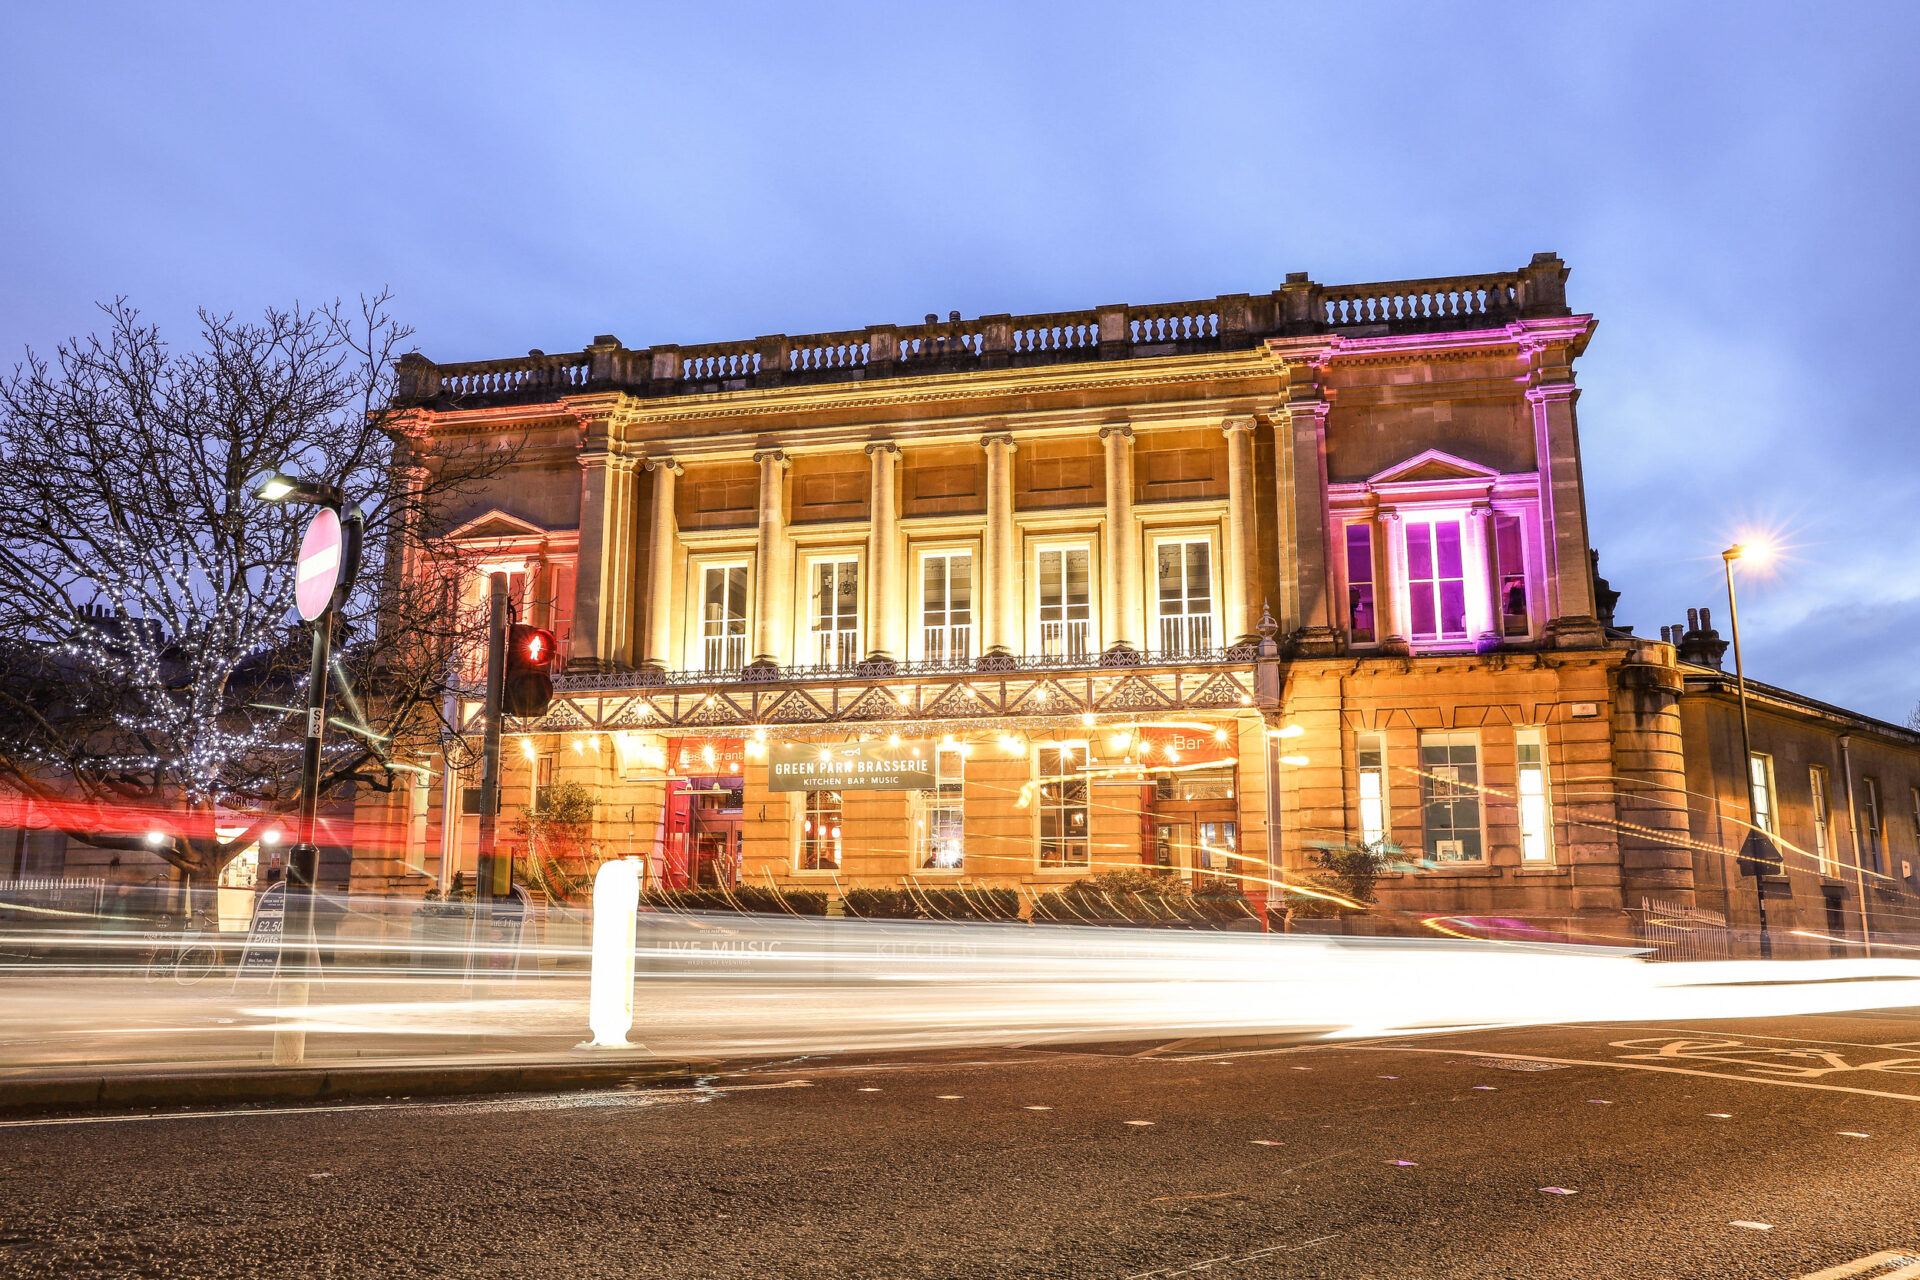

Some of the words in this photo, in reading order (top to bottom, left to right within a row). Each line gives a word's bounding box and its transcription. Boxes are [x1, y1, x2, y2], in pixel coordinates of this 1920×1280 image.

[1174, 735, 1205, 750] Bar
[681, 749, 745, 761] esurant
[775, 763, 815, 775] GREEN
[819, 761, 853, 774] PARK
[857, 759, 929, 773] BRASSERIE
[803, 777, 842, 786] KITCHEN
[847, 777, 865, 785] BAR
[870, 776, 900, 784] MUSIC
[712, 940, 782, 957] MUSIC
[876, 943, 977, 959] KITCHEN
